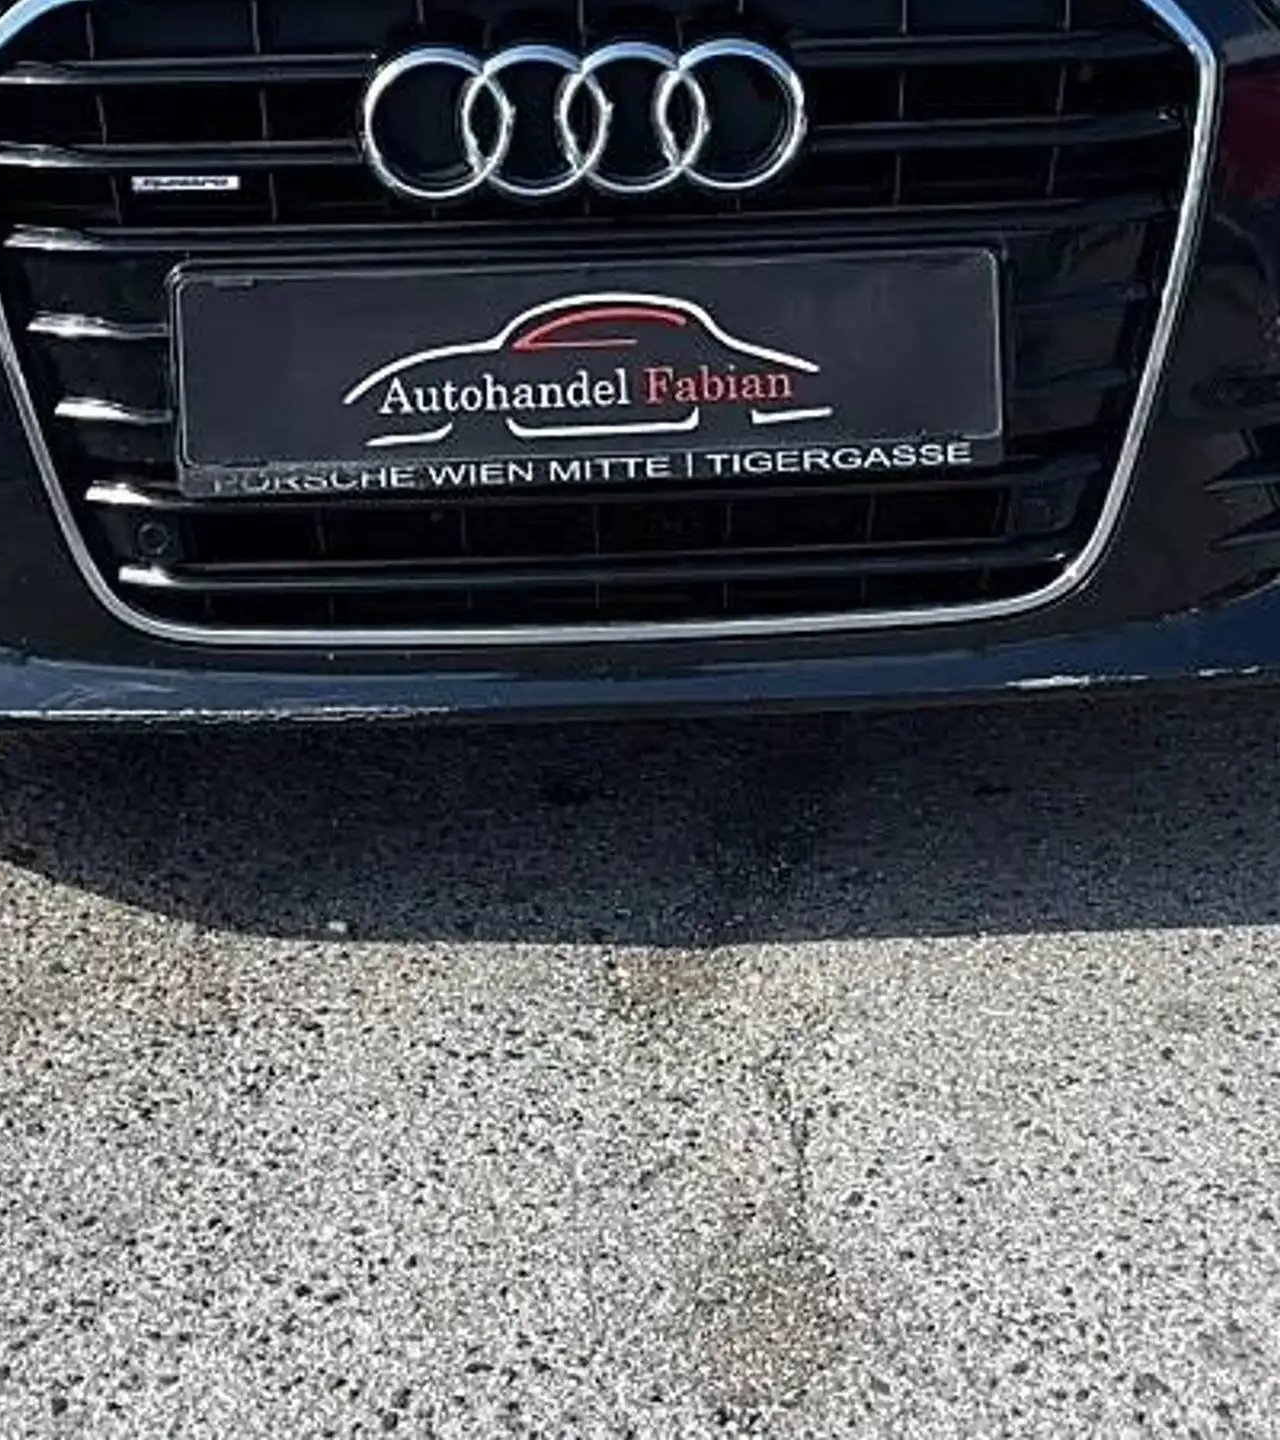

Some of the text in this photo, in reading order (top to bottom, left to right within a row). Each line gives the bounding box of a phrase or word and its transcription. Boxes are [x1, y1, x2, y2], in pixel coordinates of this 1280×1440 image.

[378, 363, 793, 416] Autohandel Fabian
[428, 461, 534, 486] WIEN
[548, 455, 670, 483] MITTE
[705, 441, 974, 475] TIGERGASSE
